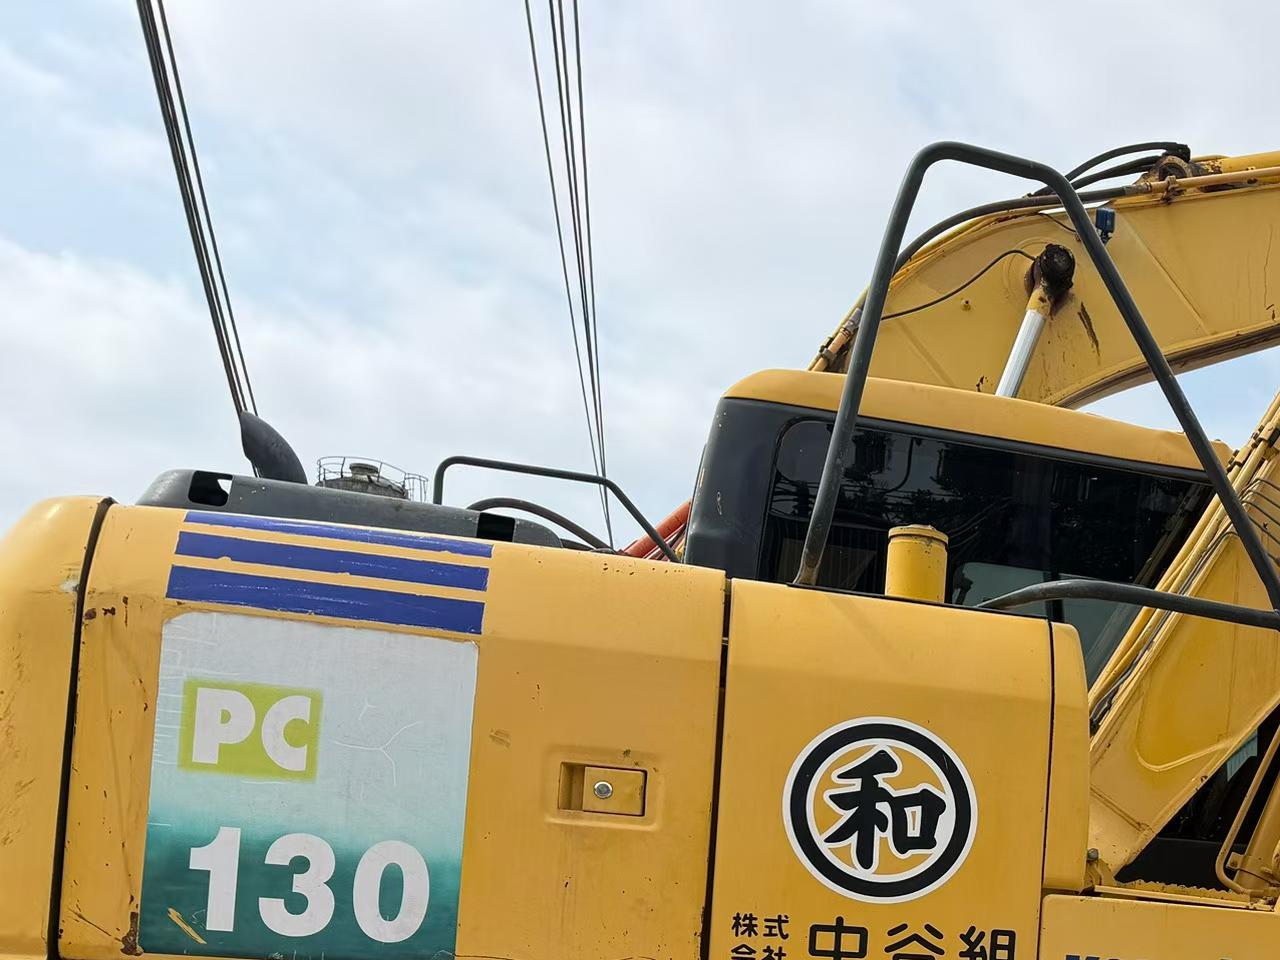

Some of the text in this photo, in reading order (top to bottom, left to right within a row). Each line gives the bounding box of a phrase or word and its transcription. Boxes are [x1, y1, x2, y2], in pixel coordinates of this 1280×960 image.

[191, 687, 311, 771] PC
[825, 749, 947, 871] 和
[189, 826, 430, 943] 130
[731, 912, 790, 940] 株式
